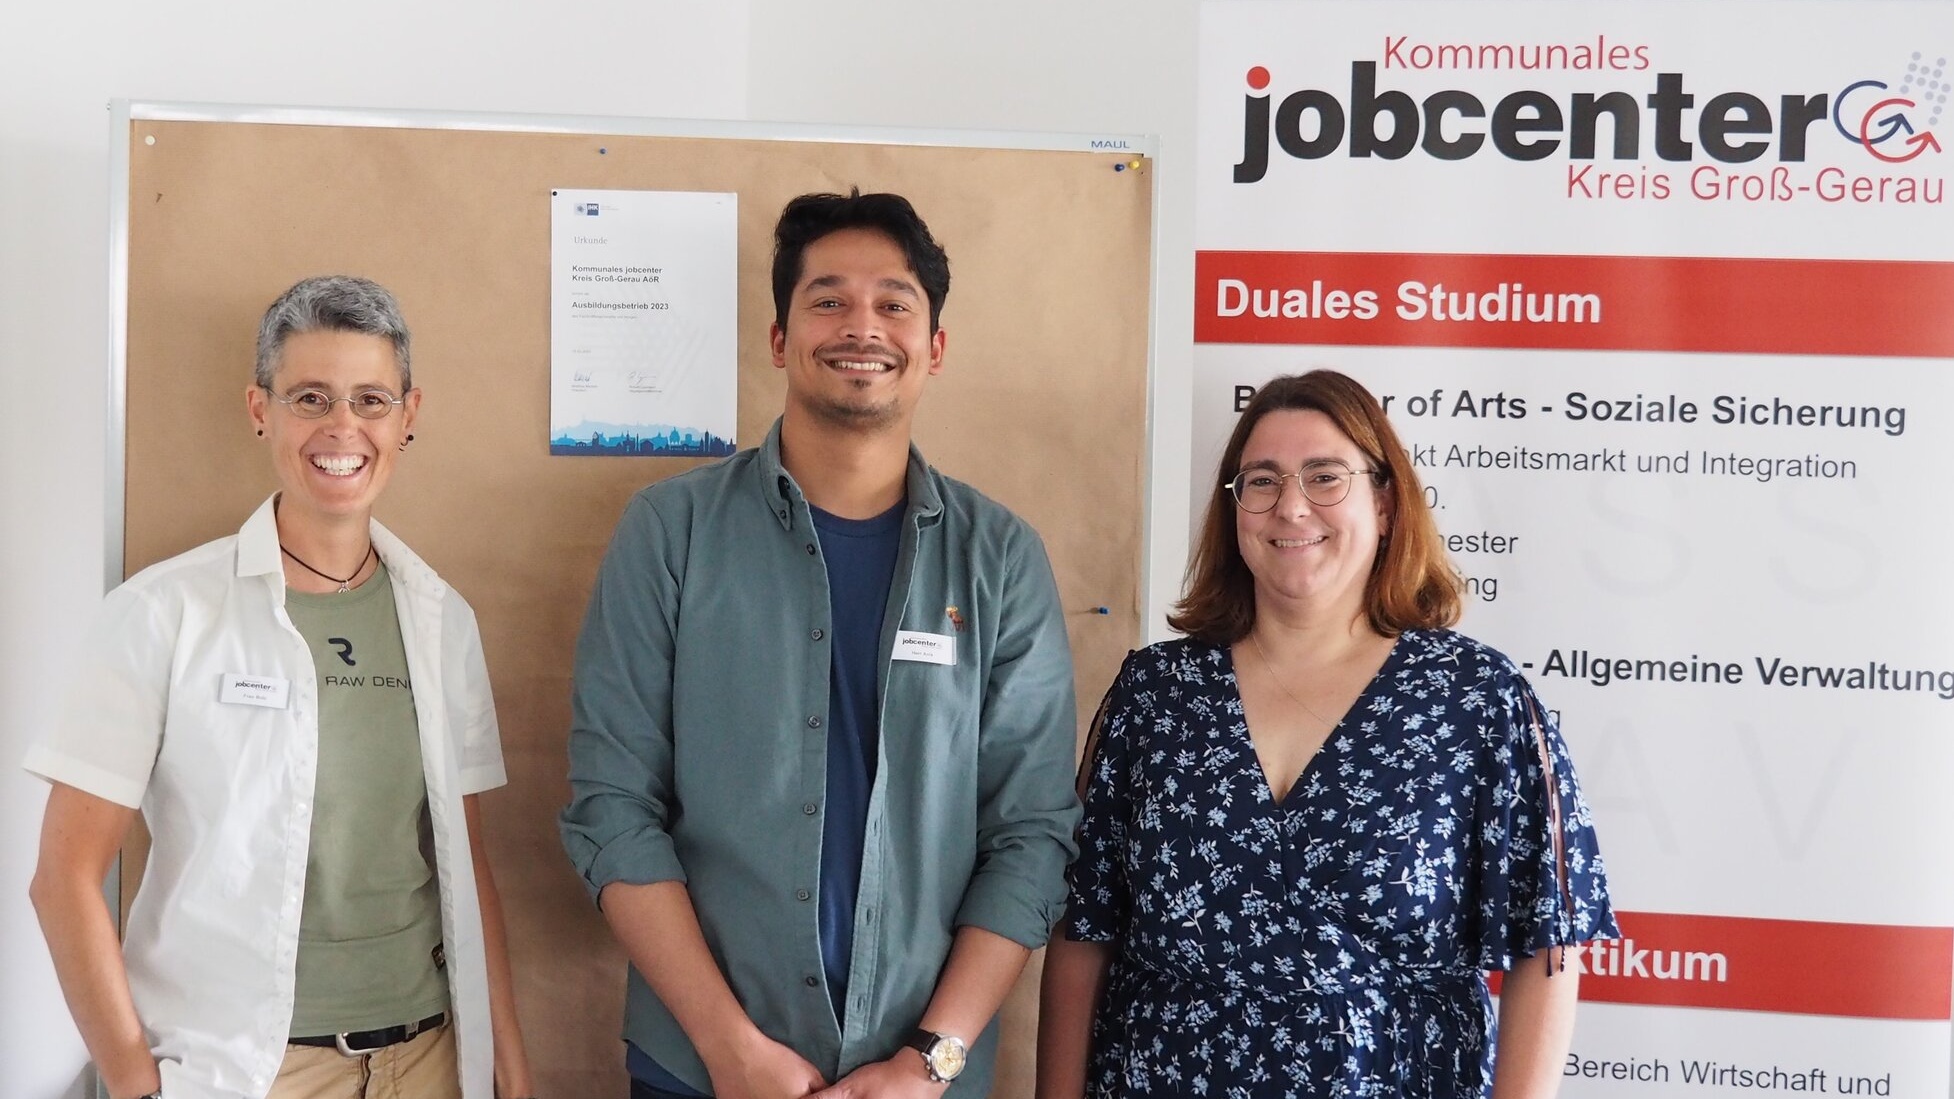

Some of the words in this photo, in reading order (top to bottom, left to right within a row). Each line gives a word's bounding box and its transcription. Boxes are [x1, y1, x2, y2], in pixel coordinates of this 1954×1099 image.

[1385, 35, 1650, 71] Kommunales
[1233, 60, 1828, 184] jobcenter
[1090, 140, 1130, 149] MAUL
[1567, 165, 1671, 200] Kreis
[1690, 166, 1943, 204] Groß-Gerau
[573, 235, 608, 245] Urkunde
[572, 265, 623, 274] Kommunales
[625, 266, 663, 275] jobcenter
[572, 274, 593, 283] Kreis
[594, 274, 641, 284] Groß-Gerau
[571, 301, 649, 311] Ausbildungsbetrieb
[650, 302, 669, 310] 2023
[1217, 279, 1379, 320] Duales
[1395, 280, 1601, 323] Studium
[1406, 388, 1444, 417] of
[1451, 389, 1527, 420] Arts
[1564, 391, 1698, 424] Soziale
[1711, 395, 1906, 437] Sicherung
[1444, 444, 1627, 473] Arbeitsmarkt
[1637, 450, 1689, 474] und
[1702, 450, 1856, 483] Integration
[1439, 530, 1519, 554] ester
[902, 637, 937, 647] jobcenter
[234, 680, 271, 691] jobcenter
[325, 675, 366, 688] RAW
[372, 676, 412, 690] DENI
[1541, 648, 1743, 687] Allgemeine
[1754, 656, 1954, 700] Verwaltung
[1577, 938, 1728, 983] ktikum
[1563, 1052, 1669, 1083] Bereich
[1680, 1059, 1827, 1093] Wirtschaft
[1837, 1072, 1891, 1097] und
